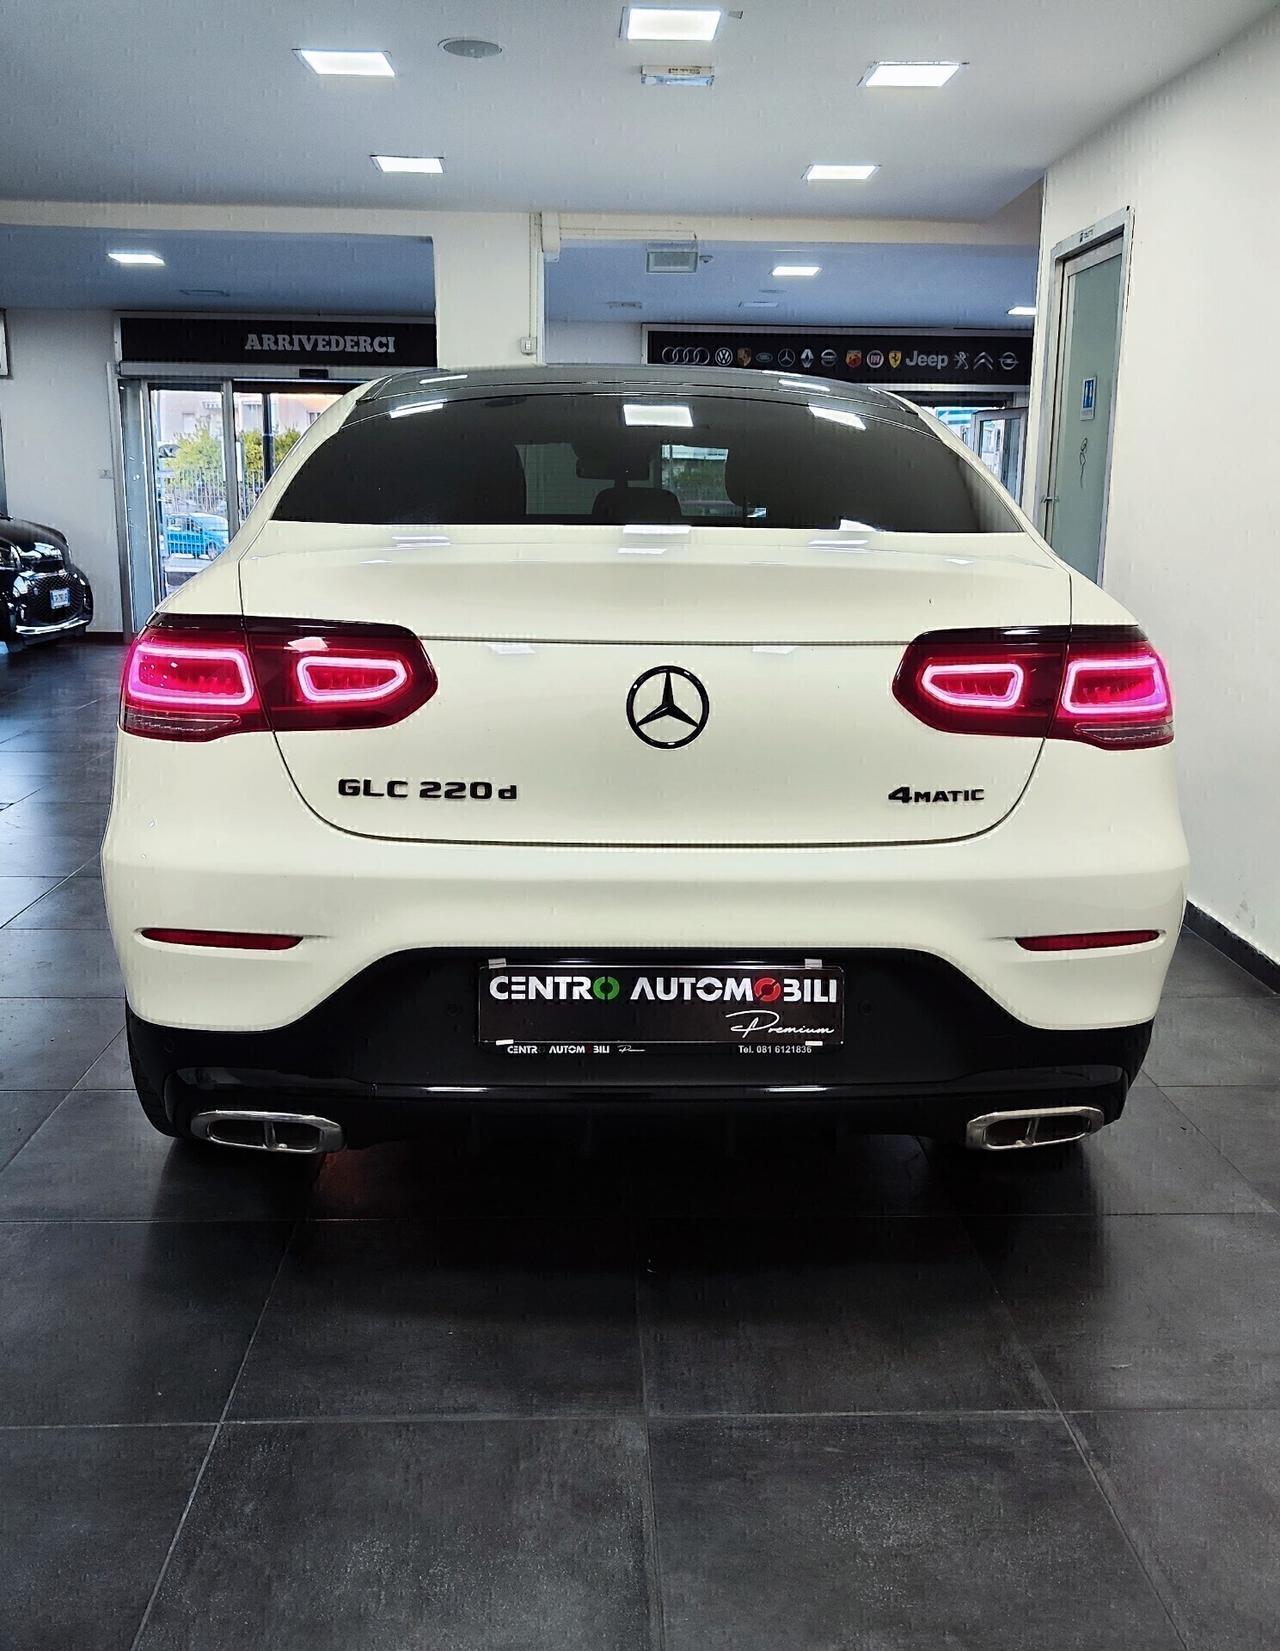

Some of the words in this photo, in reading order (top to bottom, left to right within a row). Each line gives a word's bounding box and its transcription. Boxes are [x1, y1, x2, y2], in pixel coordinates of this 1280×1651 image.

[245, 333, 396, 353] ARRIVEDERCI
[905, 350, 949, 370] Jeep
[338, 778, 409, 798] GLC
[887, 786, 985, 804] 4MATIC
[489, 975, 620, 1001] CENTRO
[630, 976, 838, 1003] AUTOMOBILI
[725, 1009, 835, 1039] Premium
[507, 1045, 546, 1055] CENTR
[549, 1045, 610, 1055] AUTOMBILI
[738, 1045, 755, 1054] Tel.
[756, 1045, 772, 1054] 081
[774, 1045, 812, 1054] 6121836
